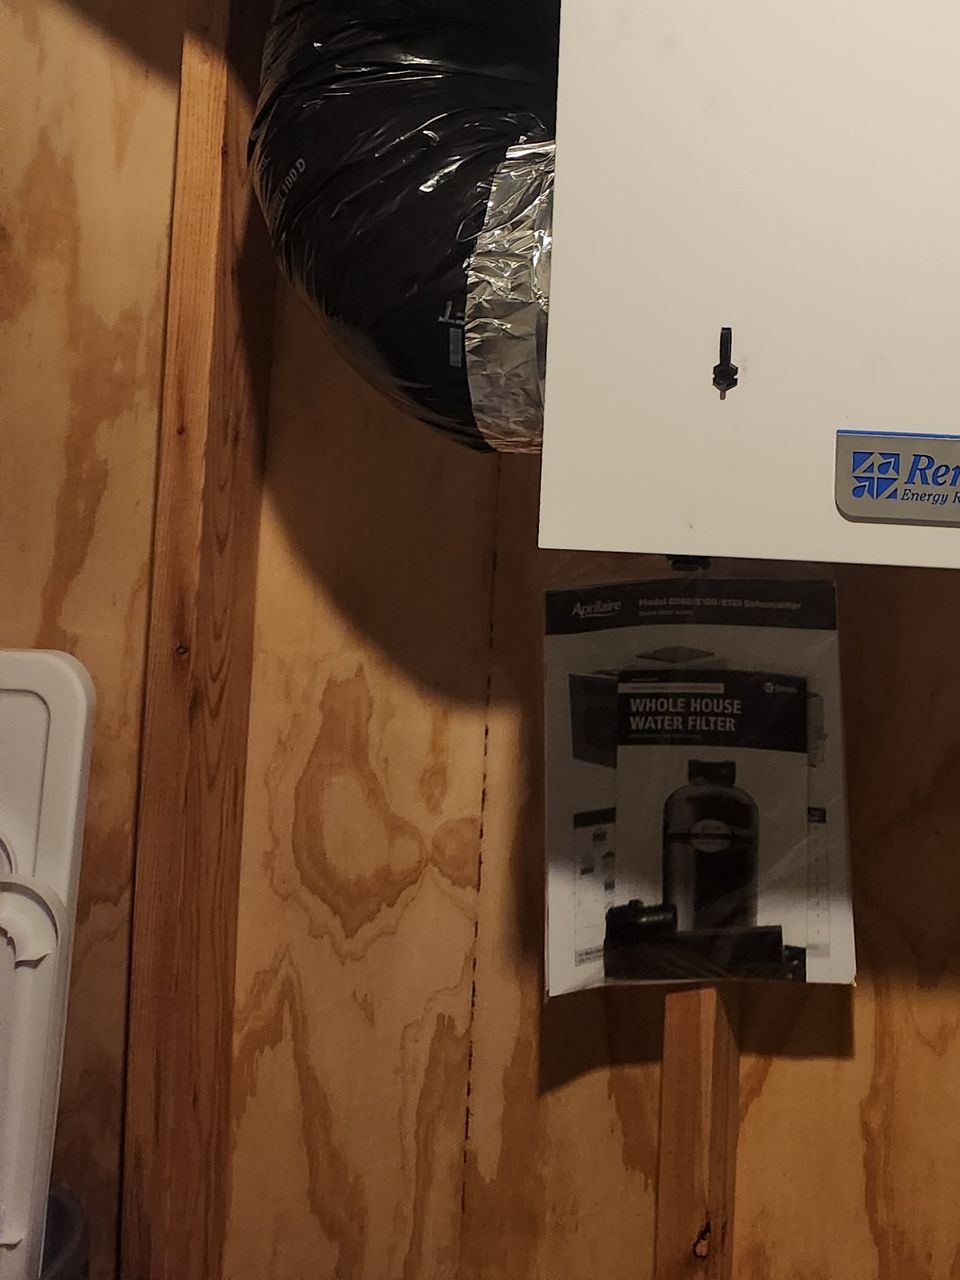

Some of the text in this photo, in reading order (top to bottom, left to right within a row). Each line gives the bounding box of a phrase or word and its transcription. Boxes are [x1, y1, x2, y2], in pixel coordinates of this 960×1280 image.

[901, 489, 949, 505] Energy
[571, 600, 622, 618] Aprilaire
[630, 698, 742, 714] WHOLE HOUSE
[630, 716, 736, 732] WATER FILTER
